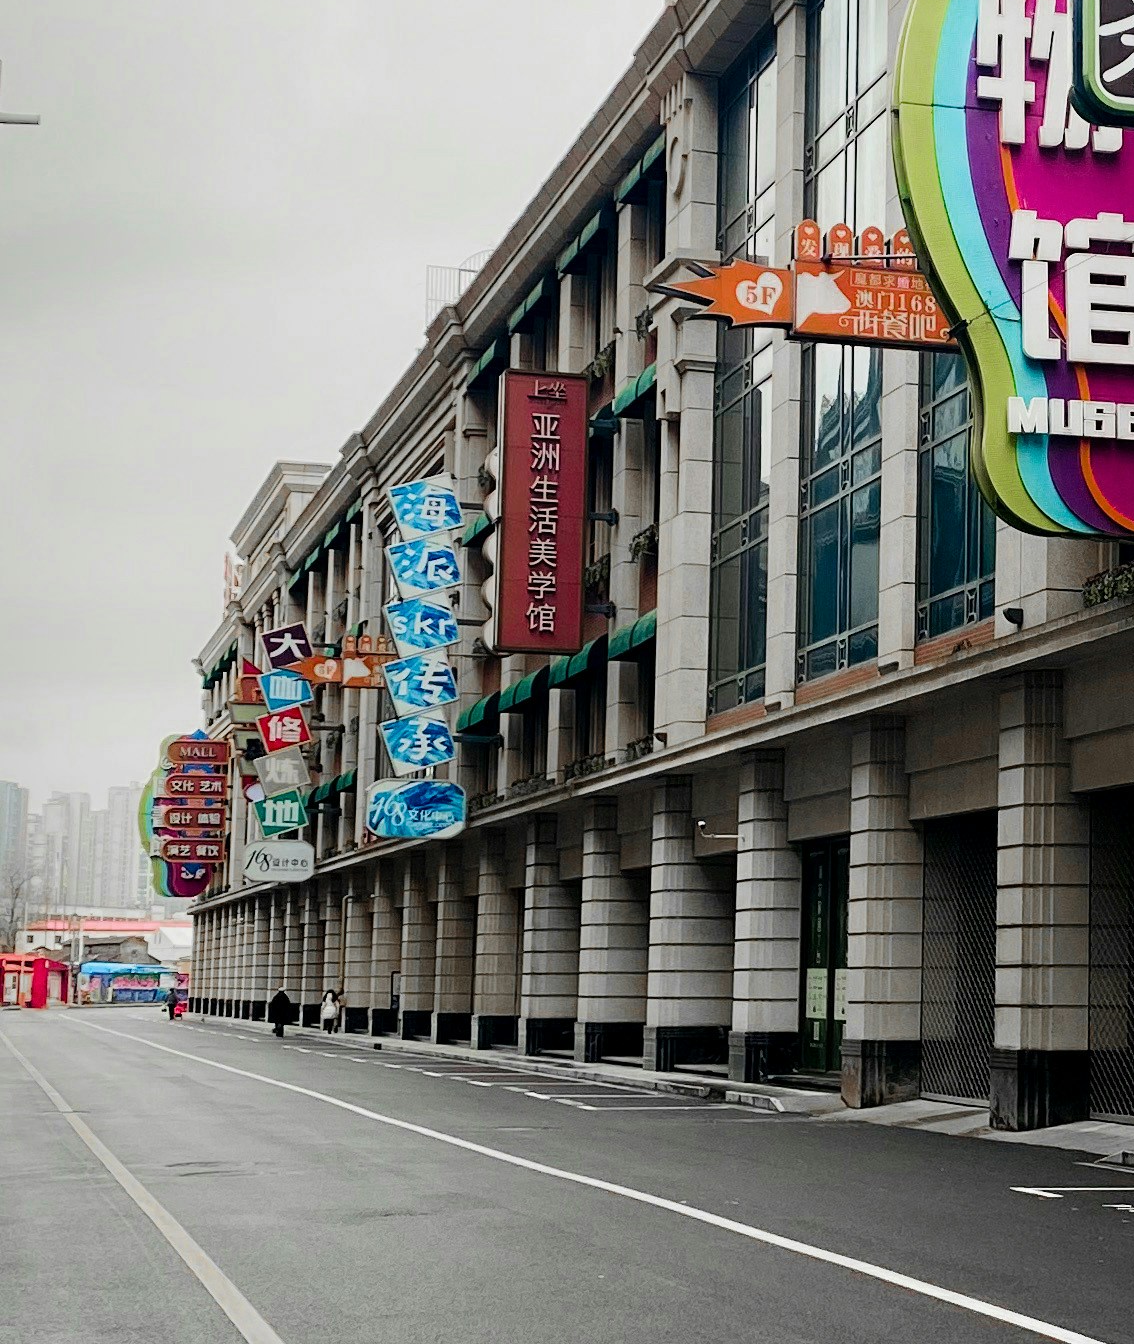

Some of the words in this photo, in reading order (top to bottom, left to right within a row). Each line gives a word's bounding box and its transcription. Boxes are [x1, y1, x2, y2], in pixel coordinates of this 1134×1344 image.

[745, 283, 778, 306] 5F
[851, 308, 939, 342] 西餐吧
[525, 412, 561, 633] 亚洲生活美学馆
[180, 746, 216, 759] MALL
